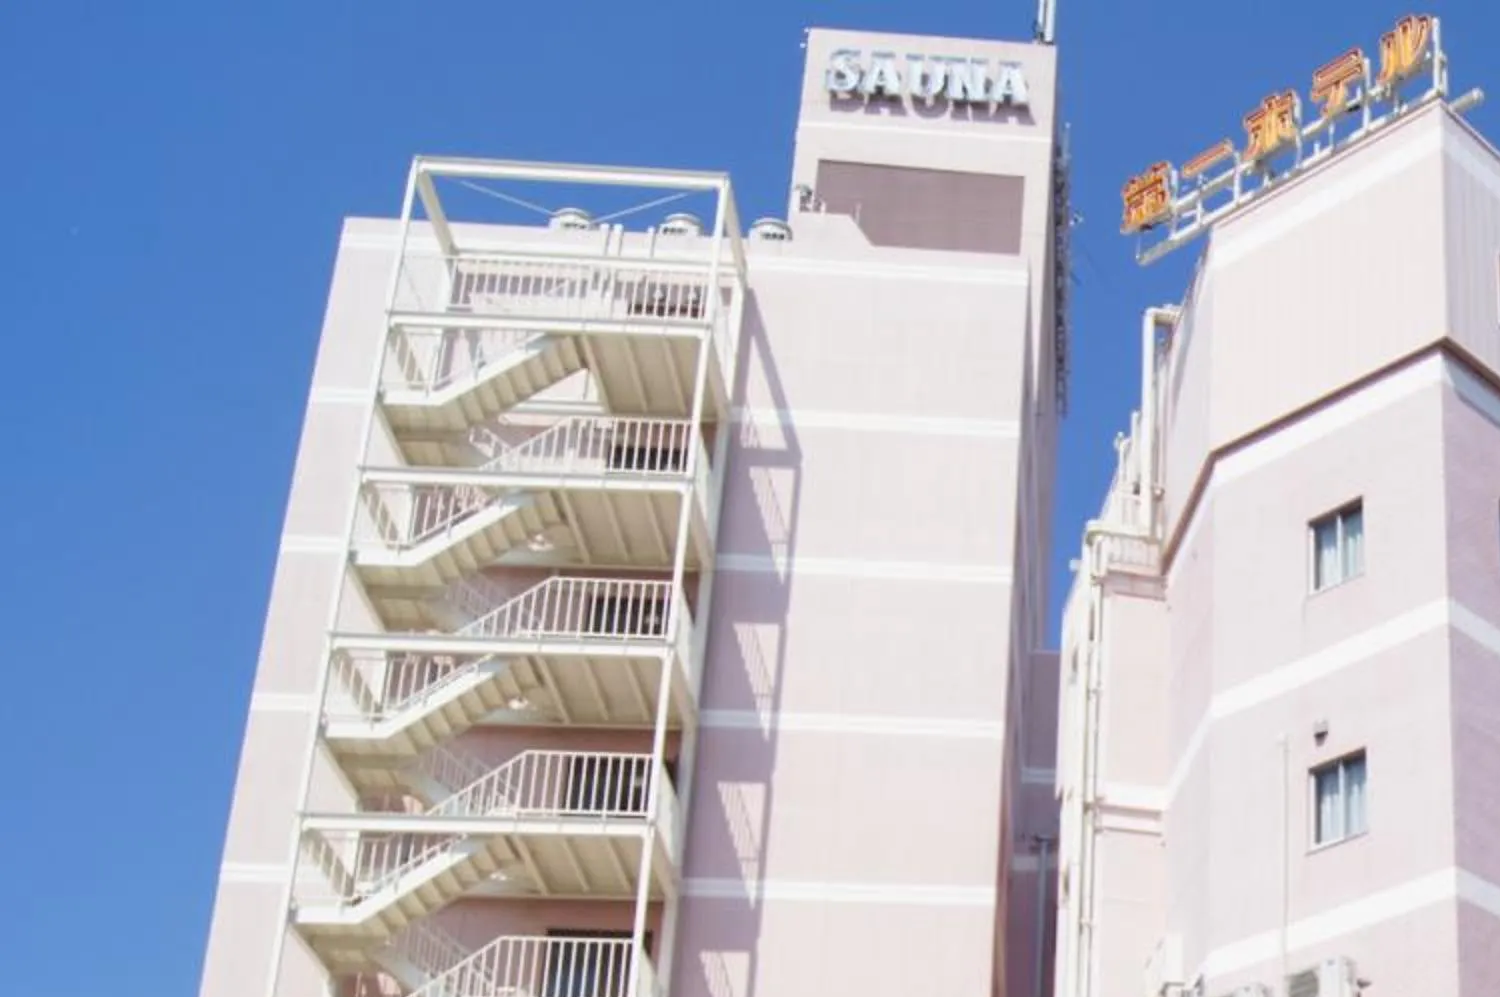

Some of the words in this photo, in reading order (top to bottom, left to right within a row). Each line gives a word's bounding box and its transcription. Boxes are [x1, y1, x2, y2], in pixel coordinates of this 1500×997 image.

[827, 49, 1027, 104] SAUNA
[1120, 14, 1435, 234] 第一ホテル
